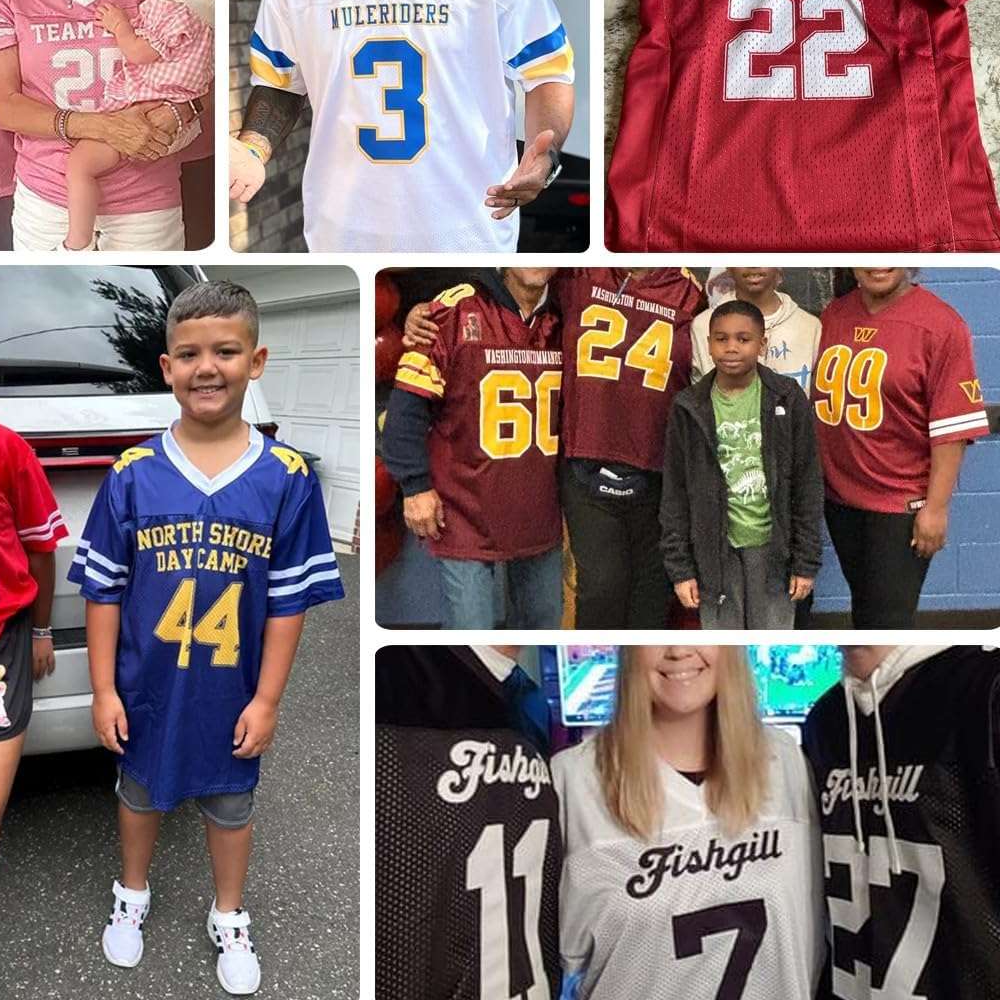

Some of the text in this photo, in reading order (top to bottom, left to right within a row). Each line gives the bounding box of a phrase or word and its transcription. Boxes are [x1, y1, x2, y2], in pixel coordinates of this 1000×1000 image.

[30, 22, 95, 44] TEAM
[331, 3, 450, 29] MULERIDERS
[351, 36, 428, 166] 3
[576, 303, 674, 392] 24
[815, 344, 888, 431] 99
[136, 520, 204, 550] NORTH
[155, 548, 249, 575] DAY CAMP
[153, 577, 245, 669] 44
[821, 764, 924, 816] Fishgill
[625, 829, 783, 899] Fishgill
[466, 818, 550, 1000] 11
[671, 897, 768, 1000] 7
